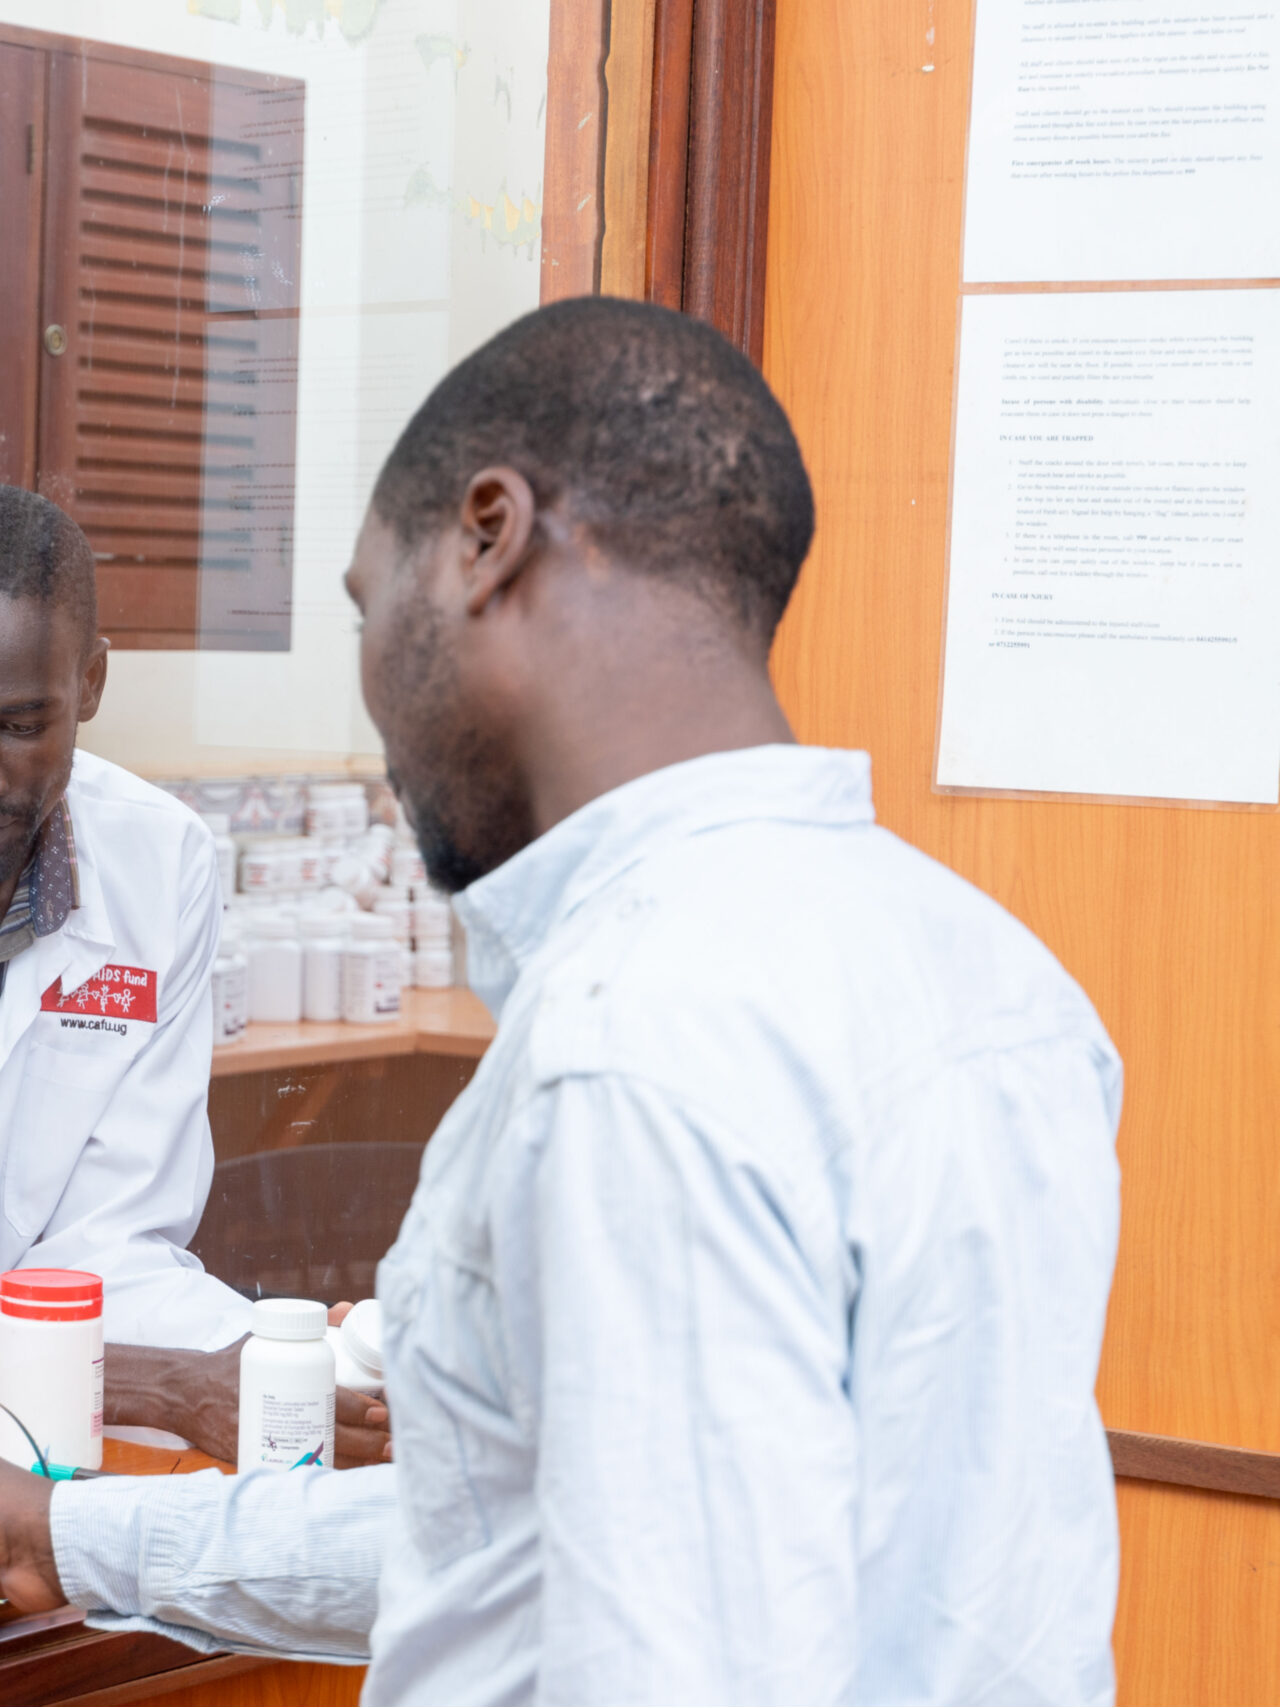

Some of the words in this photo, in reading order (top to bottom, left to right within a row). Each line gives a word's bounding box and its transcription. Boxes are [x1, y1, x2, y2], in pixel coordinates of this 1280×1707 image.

[1008, 434, 1026, 442] CASE
[1029, 434, 1042, 442] YOU
[1046, 434, 1058, 442] ARE
[1062, 434, 1093, 442] TRAPPED
[1000, 592, 1017, 600] CASE
[1019, 592, 1028, 600] OF
[123, 970, 148, 987] fund
[60, 1017, 128, 1036] www.cafu.ug
